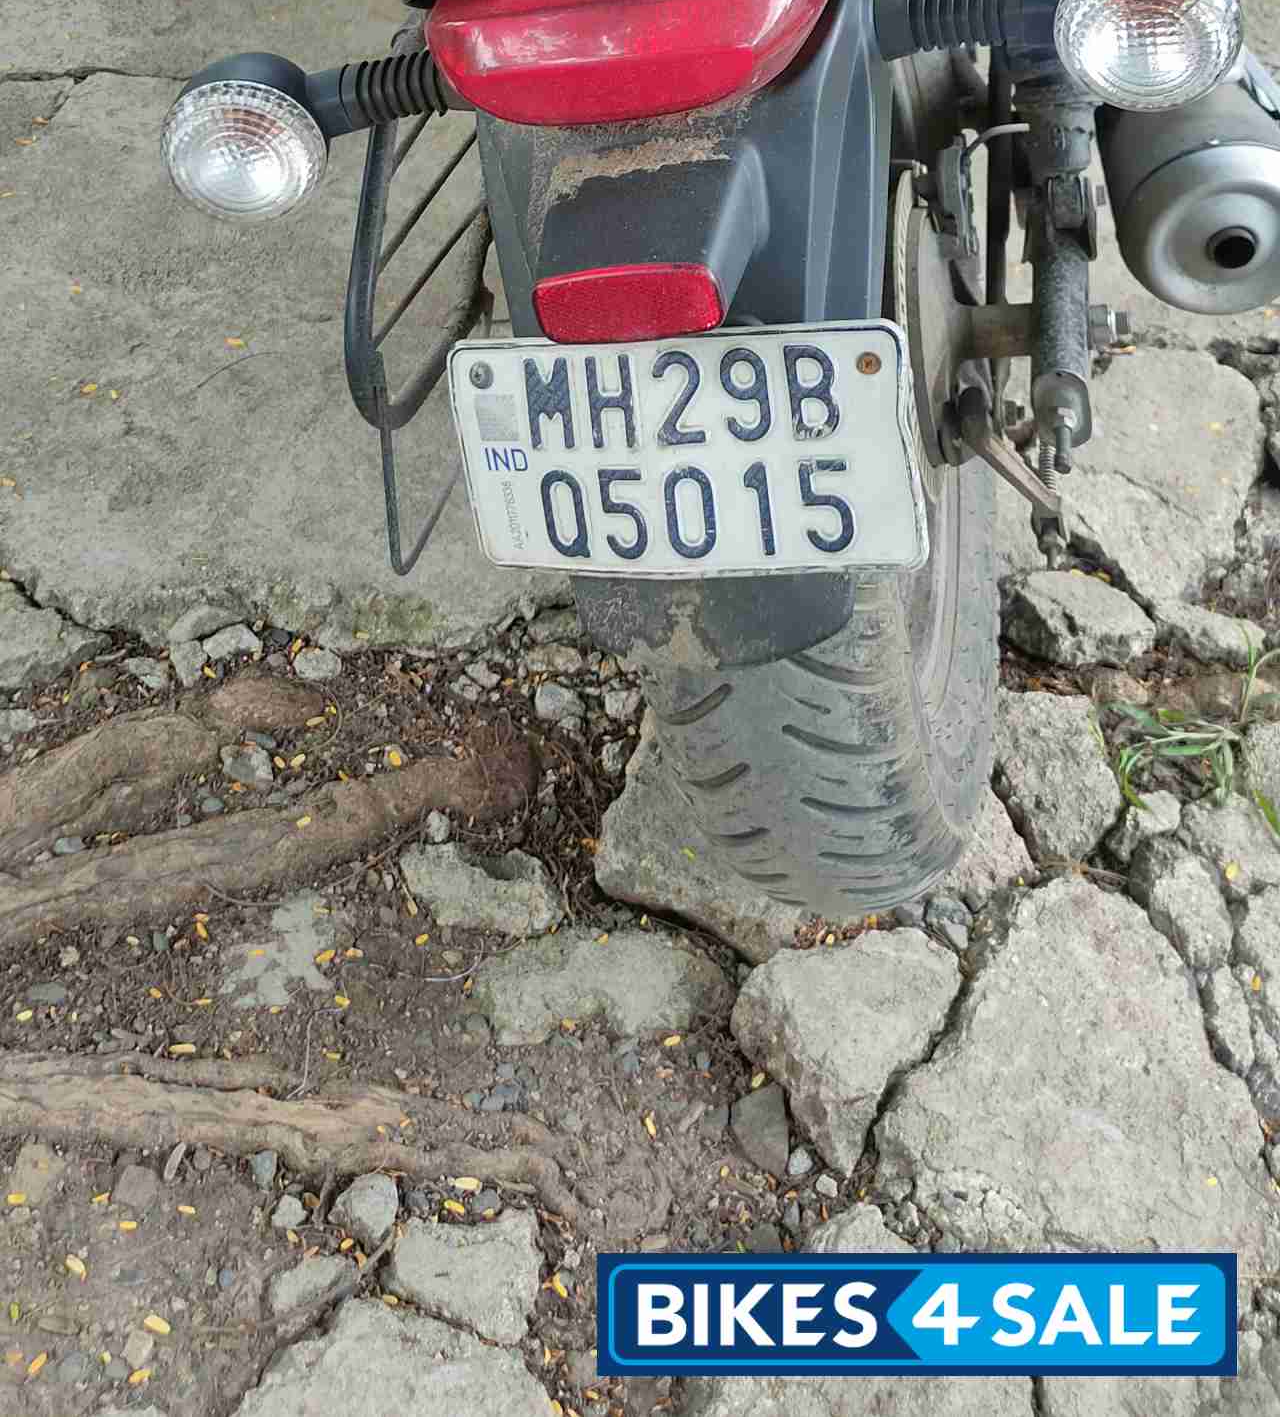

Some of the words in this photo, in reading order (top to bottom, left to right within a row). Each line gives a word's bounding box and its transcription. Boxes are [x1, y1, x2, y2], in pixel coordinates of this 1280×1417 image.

[522, 343, 842, 450] MH29B
[484, 446, 529, 472] IND
[540, 458, 855, 560] Q5015
